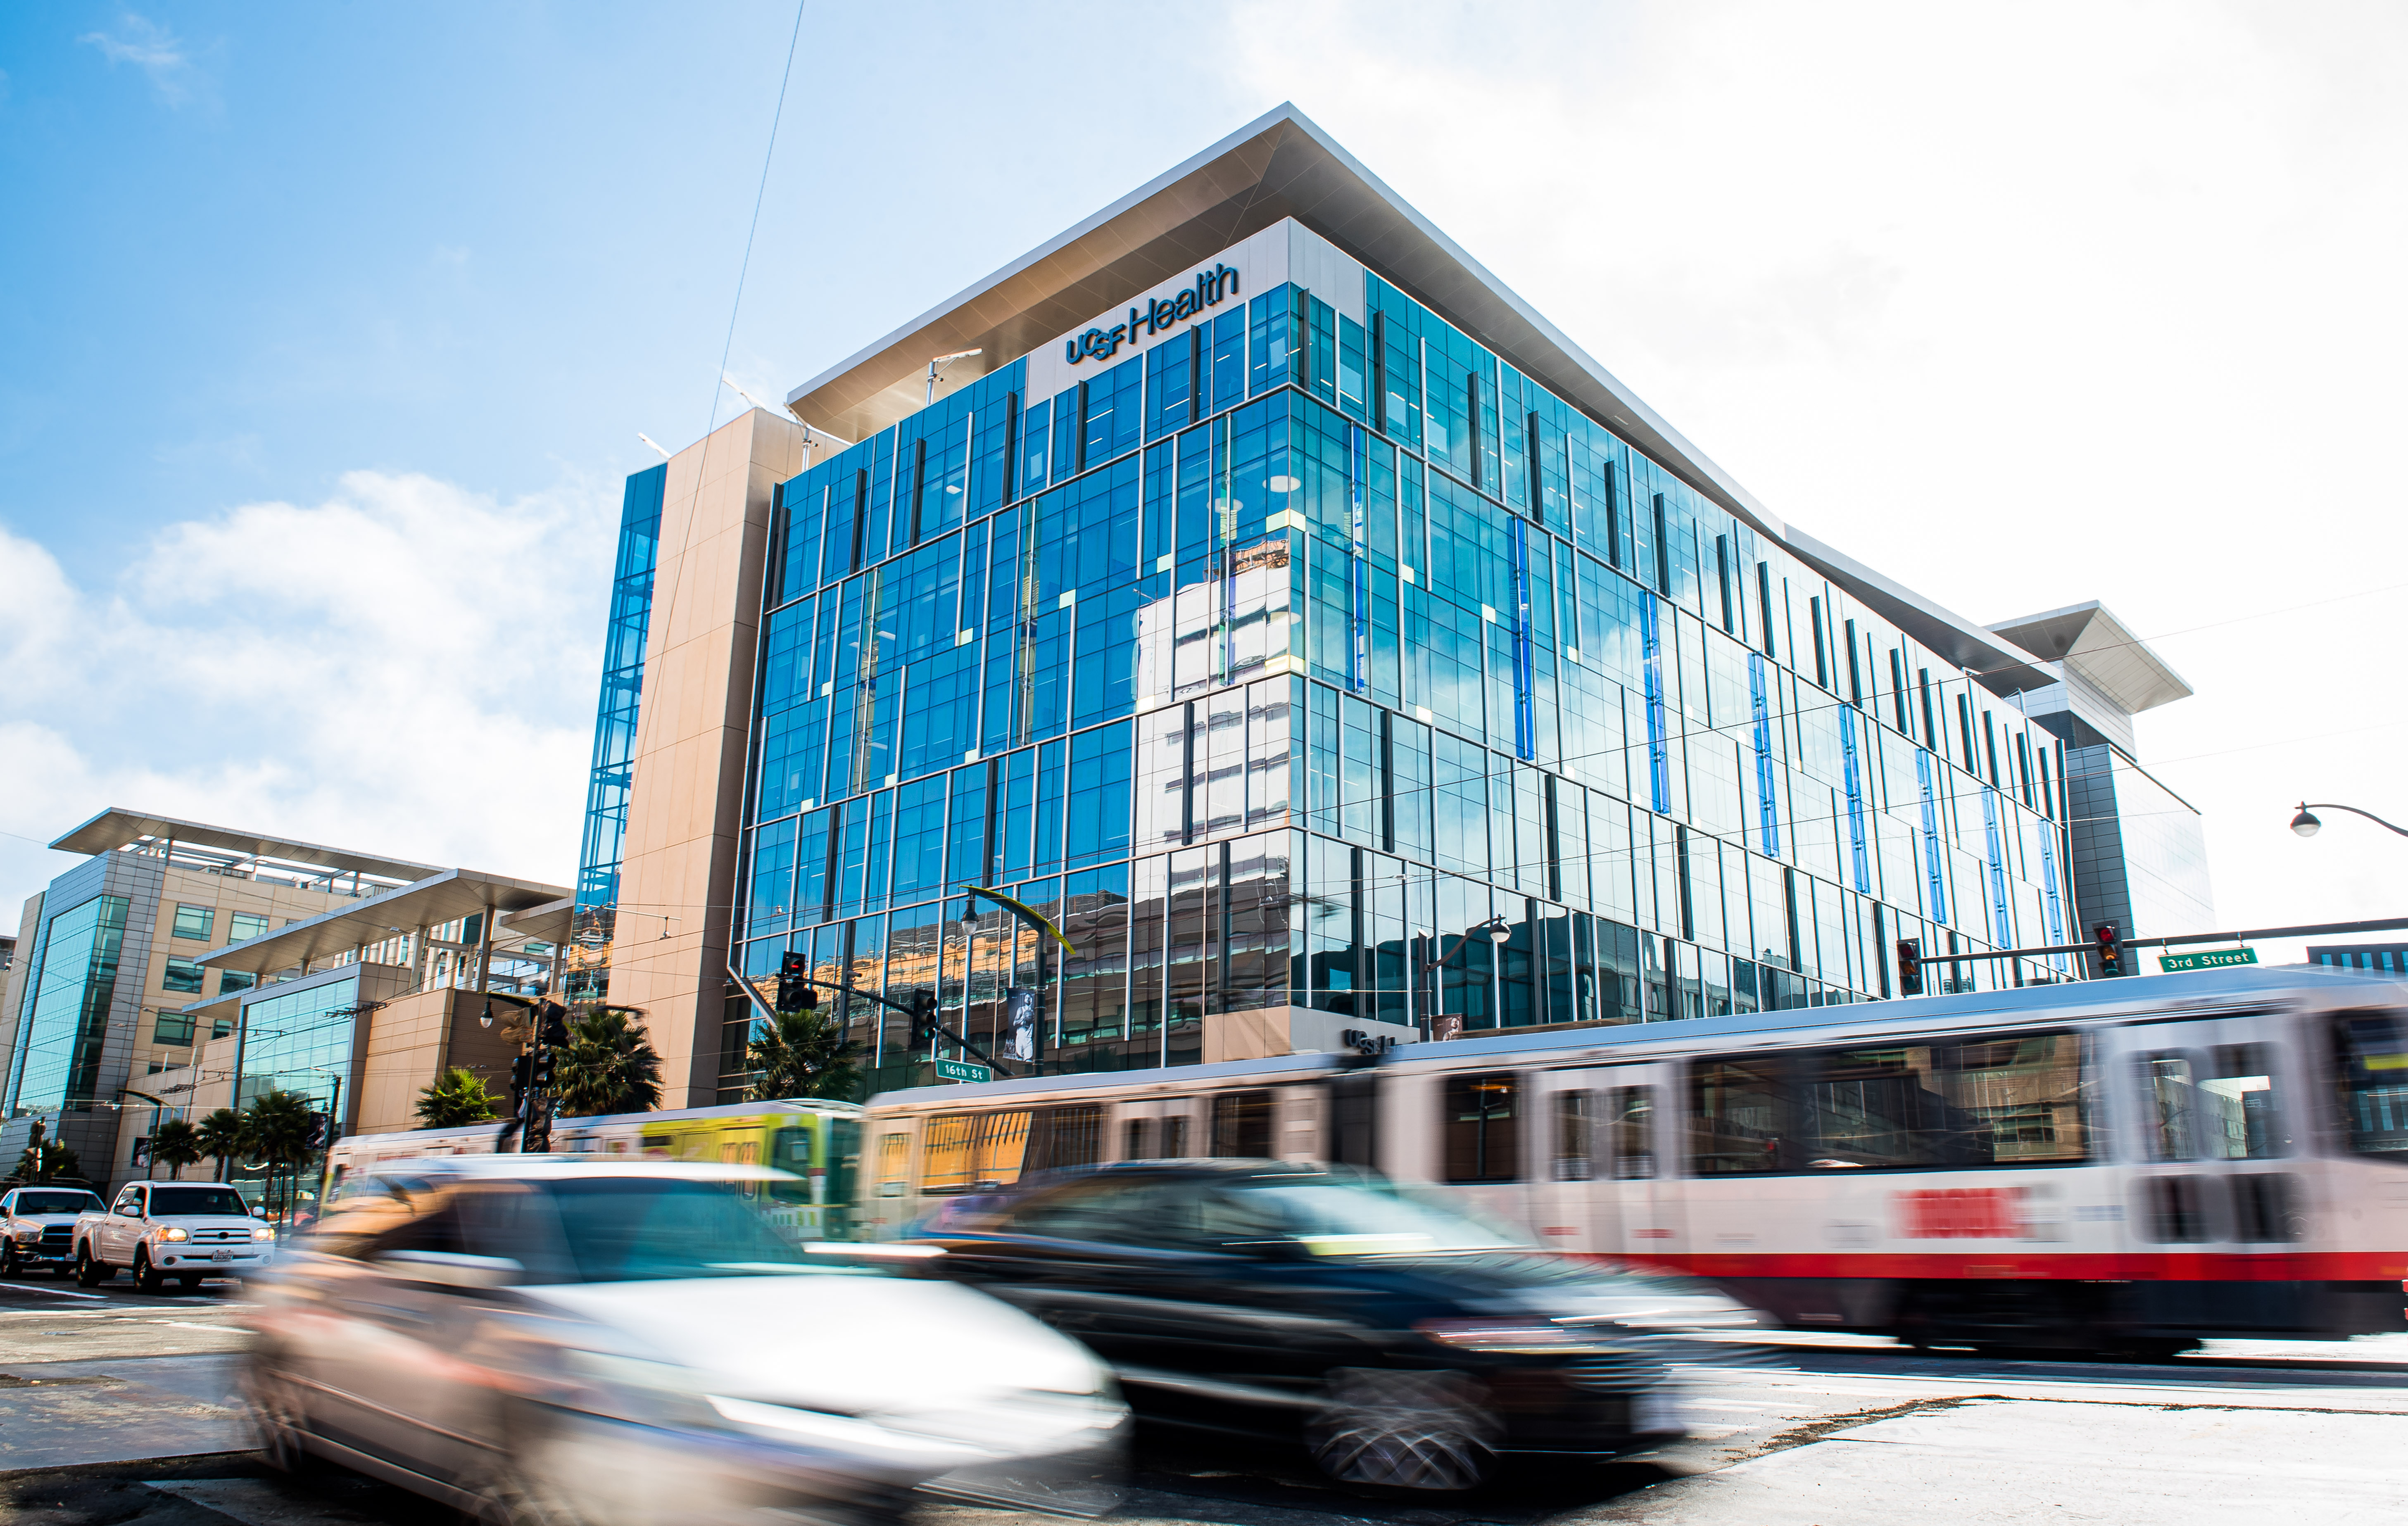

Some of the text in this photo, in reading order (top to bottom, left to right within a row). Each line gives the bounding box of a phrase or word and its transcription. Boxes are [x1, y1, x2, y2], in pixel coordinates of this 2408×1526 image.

[1066, 263, 1237, 364] UCSF Health
[2168, 952, 2249, 968] 3rd Street
[945, 1064, 983, 1079] 16th St
